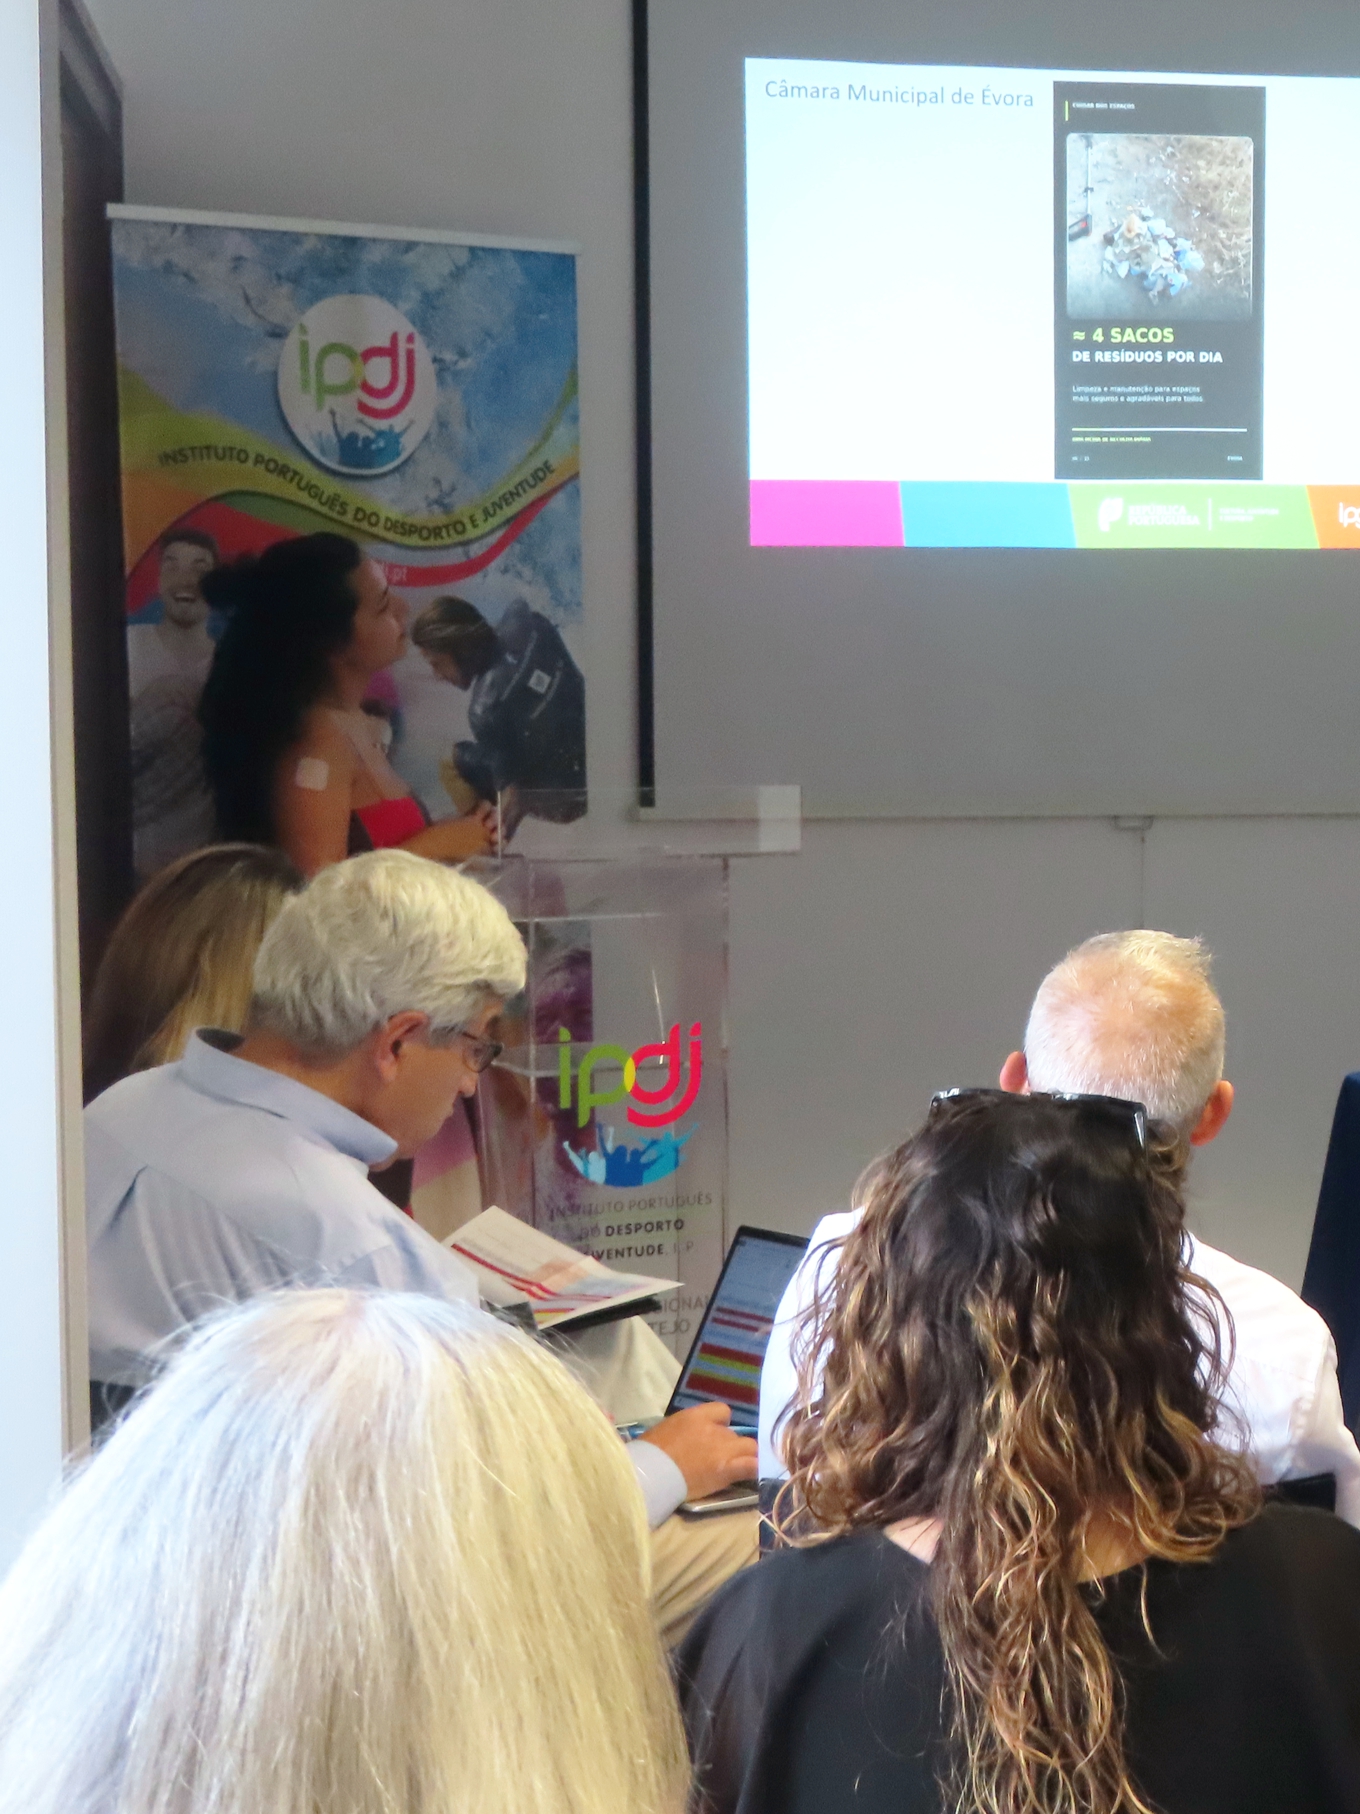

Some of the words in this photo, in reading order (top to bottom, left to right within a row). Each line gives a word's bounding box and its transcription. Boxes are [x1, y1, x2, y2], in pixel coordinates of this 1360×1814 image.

[765, 79, 840, 100] Câmara
[848, 84, 945, 107] Municipal
[951, 88, 974, 104] de
[982, 85, 1034, 107] Évora
[1092, 328, 1105, 343] 4
[1110, 327, 1175, 343] SACOS
[1072, 351, 1091, 362] DE
[1094, 349, 1163, 363] RESÍDUOS
[1167, 351, 1195, 363] POR
[1199, 351, 1223, 363] DIA
[297, 320, 416, 420] ipdj
[159, 444, 250, 467] INSTITUTO
[253, 452, 349, 517] PORTUGUÊS
[353, 505, 381, 528] DO
[383, 516, 467, 542] DESPORTO
[469, 513, 480, 529] E
[482, 459, 556, 524] JUVENTUDE
[559, 1022, 702, 1128] ipdj
[628, 1192, 713, 1213] PORTUGUÊS
[605, 1217, 686, 1238] DESPORTO
[648, 1318, 692, 1336] TEJO
